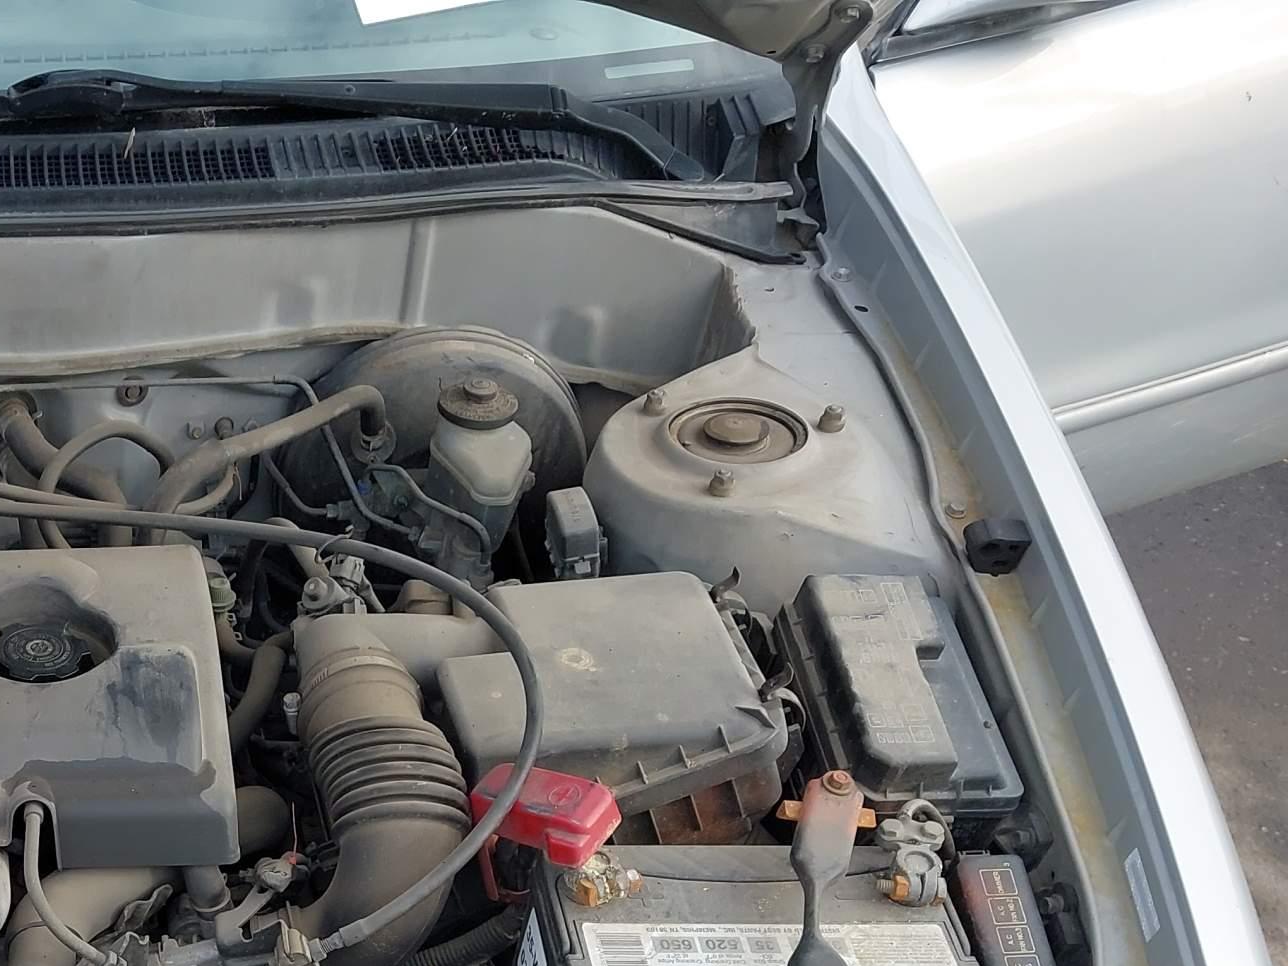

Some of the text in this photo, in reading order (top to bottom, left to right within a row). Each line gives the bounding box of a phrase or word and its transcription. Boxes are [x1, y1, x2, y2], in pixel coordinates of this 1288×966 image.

[659, 939, 692, 951] 650
[705, 939, 738, 951] 520
[755, 940, 775, 950] 35
